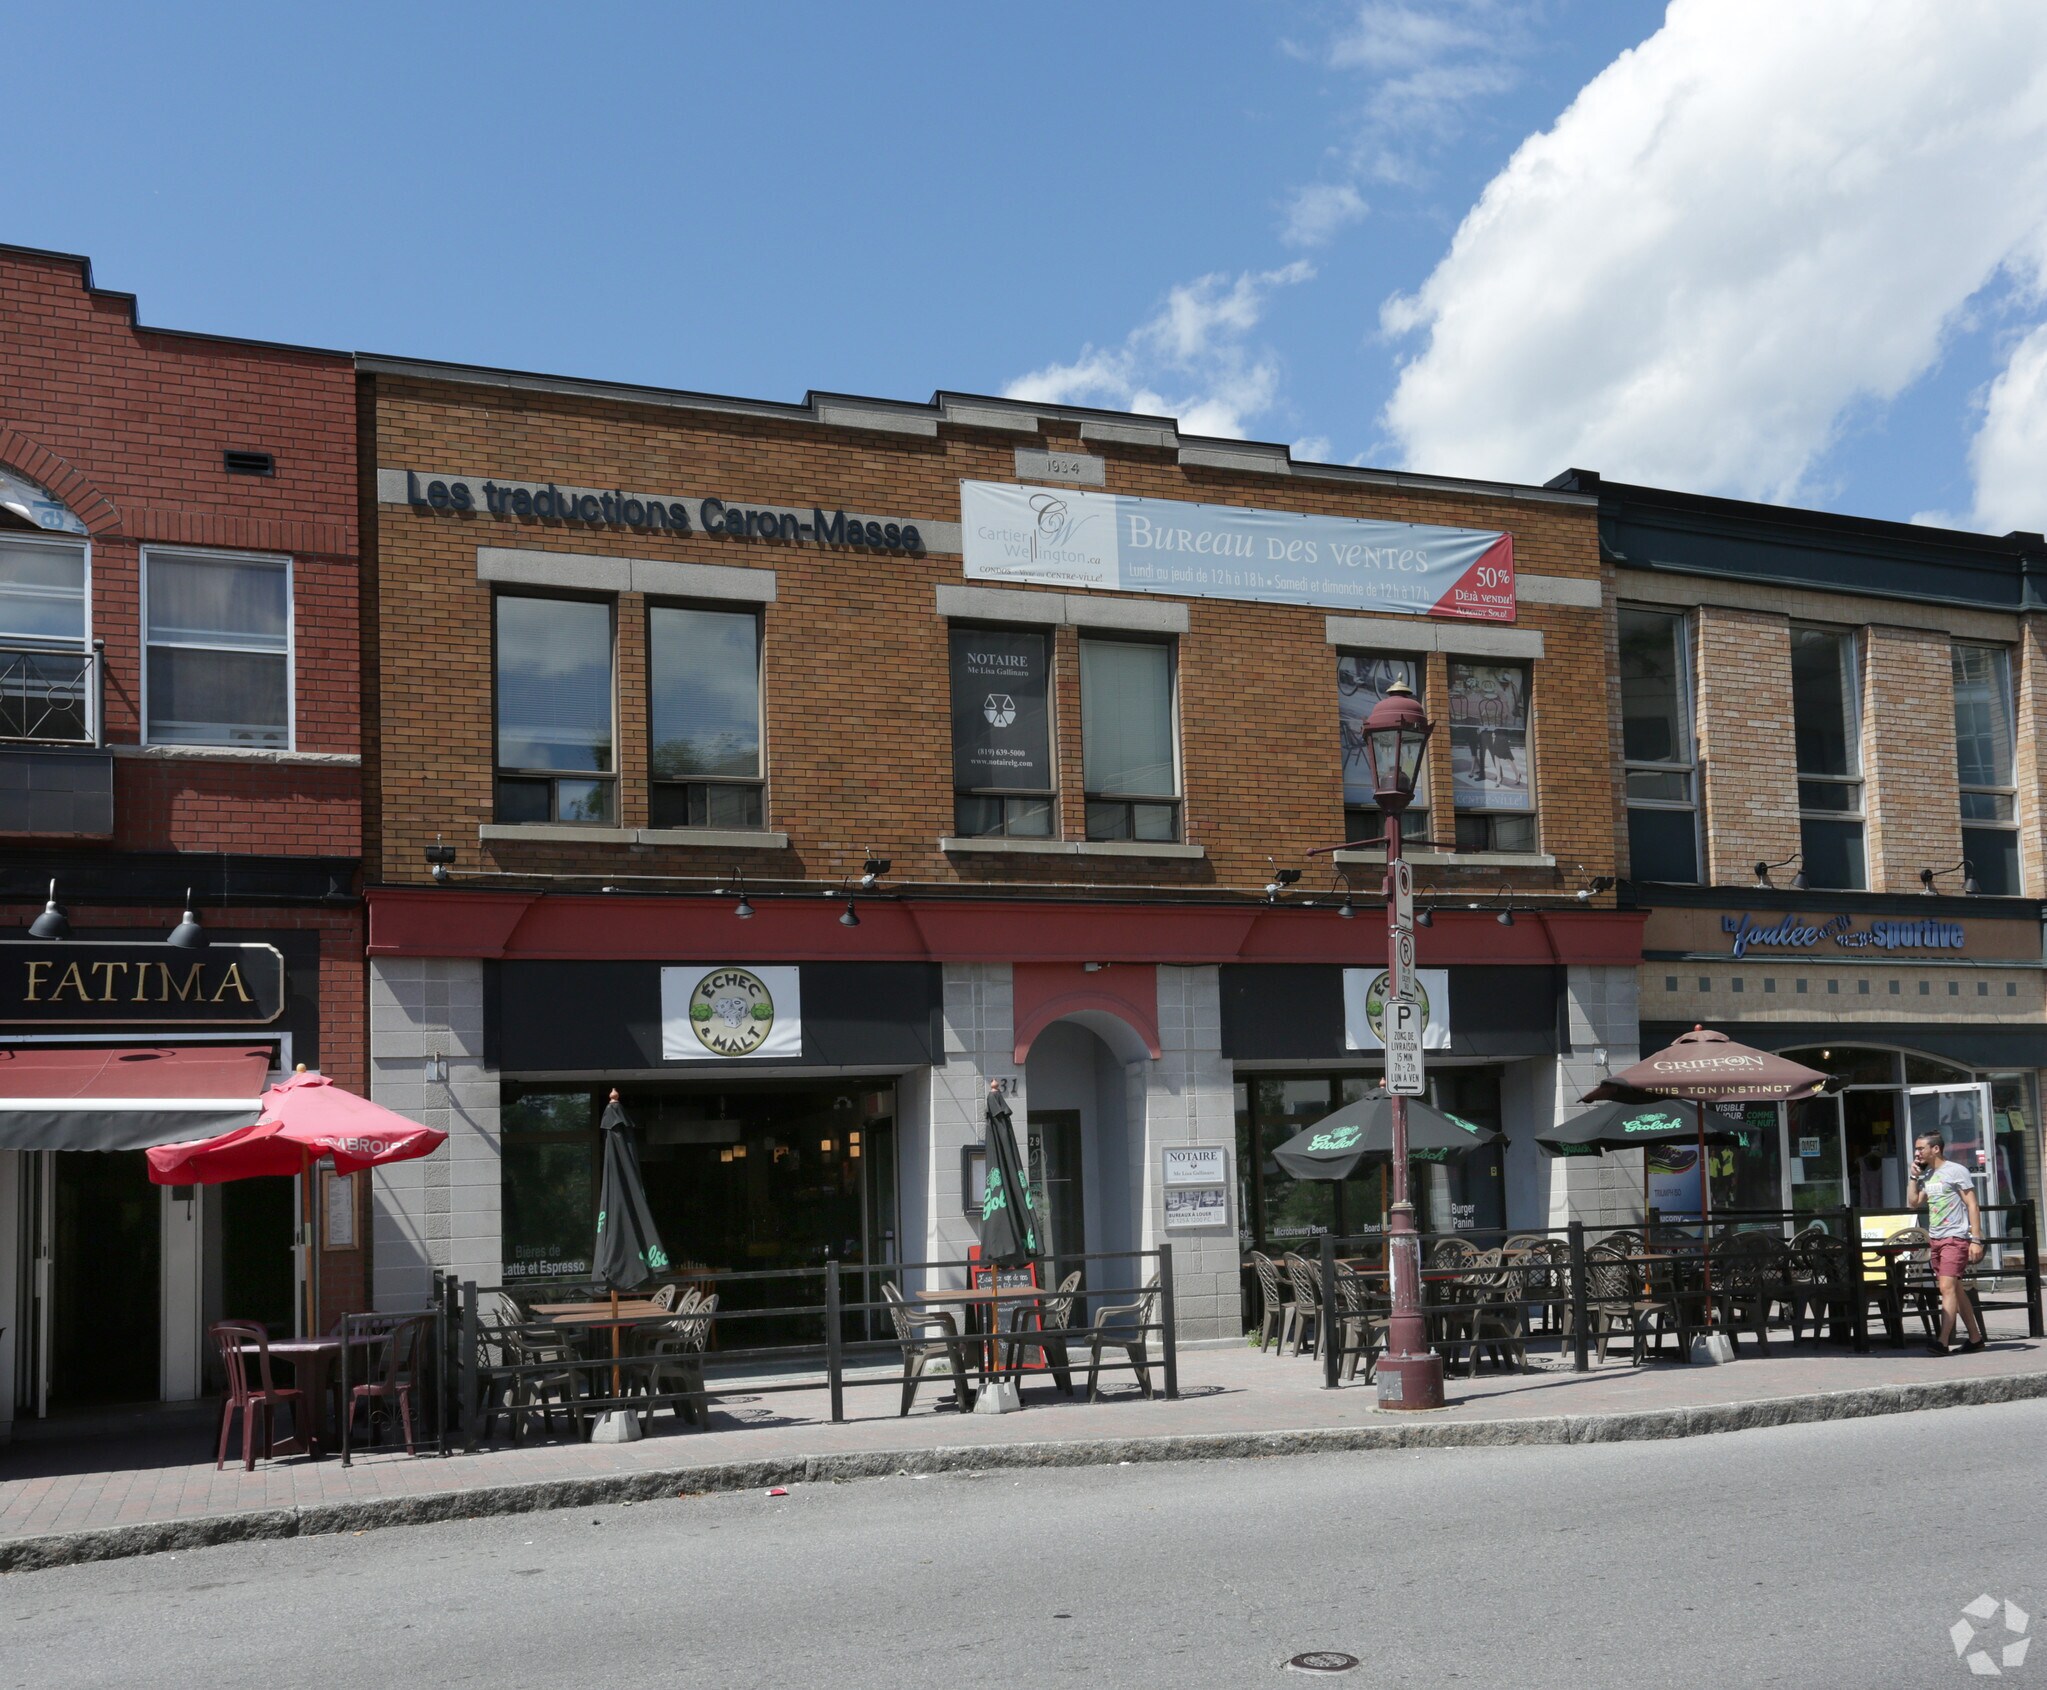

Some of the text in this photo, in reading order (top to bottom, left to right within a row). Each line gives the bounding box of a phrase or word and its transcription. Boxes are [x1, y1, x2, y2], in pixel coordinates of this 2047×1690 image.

[1046, 459, 1080, 475] 1934
[407, 470, 921, 550] Les traductions Caron-Masse
[978, 526, 1027, 543] Cartier
[1129, 562, 1154, 579] Lundi
[1156, 568, 1168, 580] au
[1171, 565, 1193, 584] jeudi
[1196, 568, 1208, 583] de
[1234, 571, 1241, 586] à
[1274, 574, 1308, 592] Samedi
[1311, 580, 1319, 593] et
[1322, 578, 1364, 596] dimanche
[1366, 582, 1377, 597] de
[1402, 585, 1408, 600] à
[1476, 566, 1510, 588] 50%
[967, 652, 1028, 668] NOTAIRE
[967, 666, 1029, 677] Me Lisa Gallinaro
[977, 748, 995, 757] (819)
[1733, 913, 1820, 959] foulée
[1871, 919, 1965, 951] sportive
[23, 960, 254, 1003] FATIMA
[701, 973, 762, 999] ÉCHEC
[1397, 1005, 1411, 1030] P
[712, 1025, 762, 1053] MALT
[1407, 1031, 1414, 1041] DE
[1391, 1042, 1418, 1051] LIVRAISON
[1396, 1052, 1413, 1062] 15 MIN
[1653, 1055, 1765, 1071] GRIFFON
[1391, 1073, 1401, 1083] LUN
[1409, 1073, 1419, 1082] VEN
[1688, 1085, 1717, 1095] TON
[1721, 1084, 1792, 1095] INSTINCT
[1715, 1103, 1745, 1112] VISIBLE
[1747, 1111, 1775, 1119] COMME
[1622, 1117, 1682, 1133] Grolsch
[1169, 1151, 1217, 1162] NOTAIRE
[1451, 1203, 1475, 1216] Burger
[1363, 1223, 1380, 1232] Board
[1452, 1217, 1475, 1229] Panini
[1273, 1225, 1328, 1237] Microbrewery Beers
[1863, 1231, 1878, 1239] 30%
[515, 1243, 561, 1259] Bières de
[502, 1259, 585, 1276] Latté et Espresso
